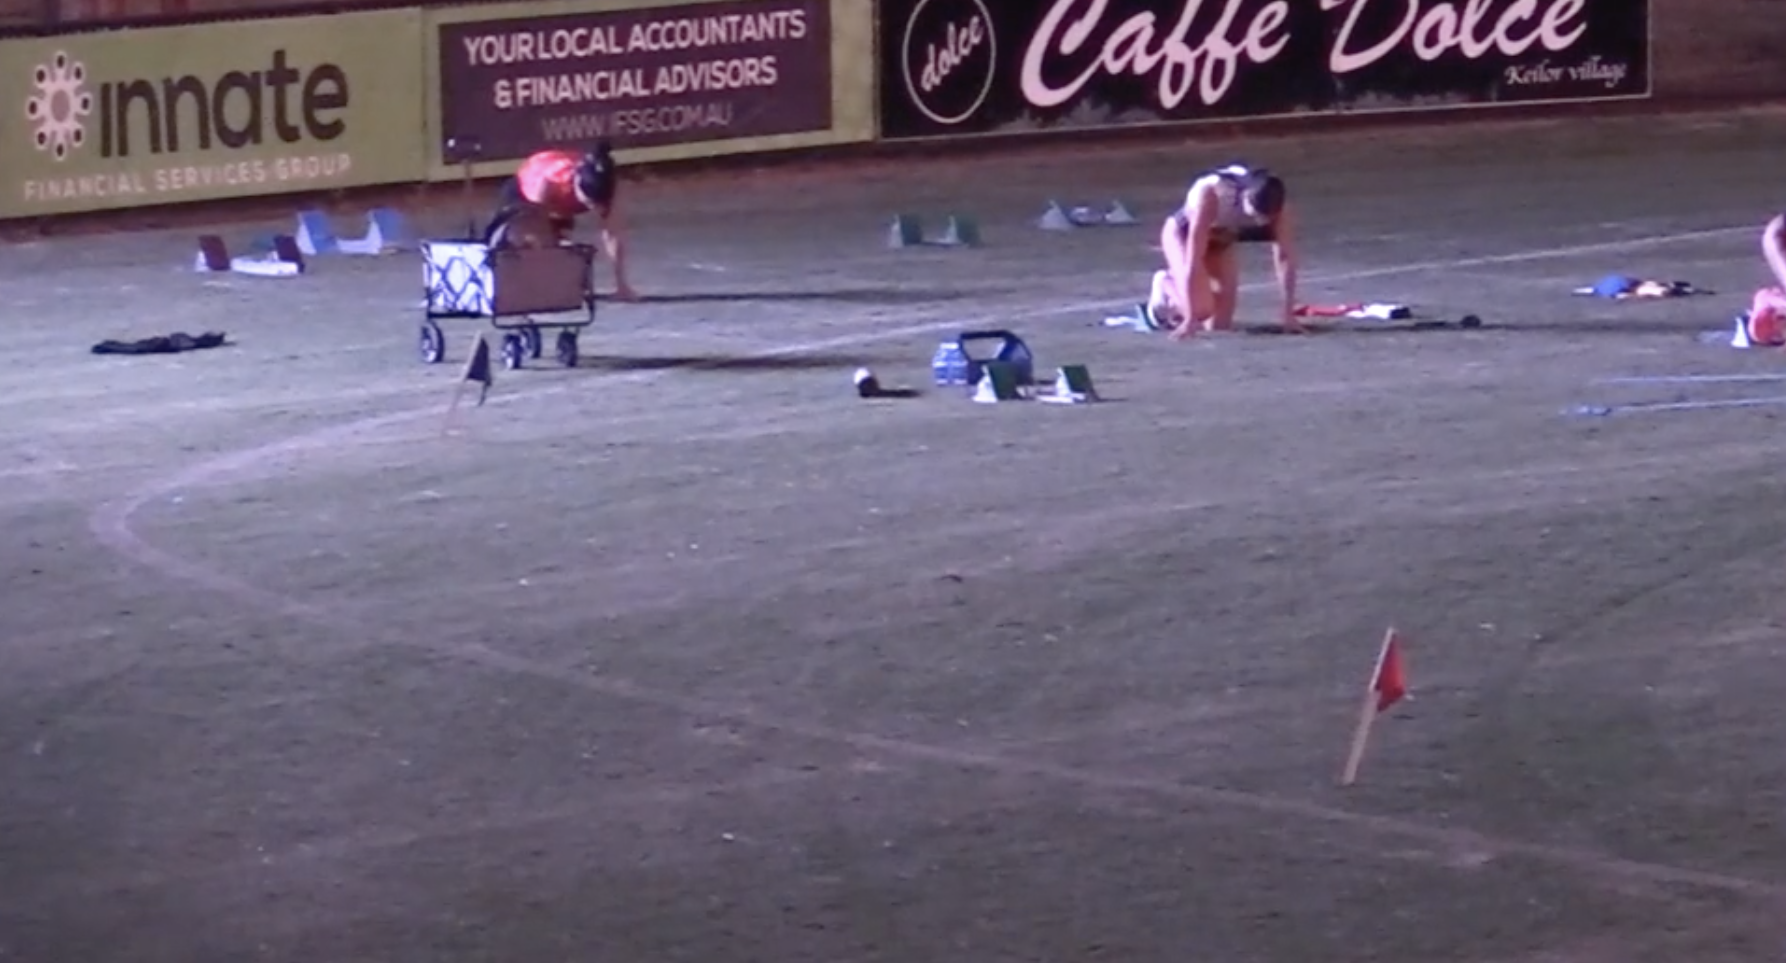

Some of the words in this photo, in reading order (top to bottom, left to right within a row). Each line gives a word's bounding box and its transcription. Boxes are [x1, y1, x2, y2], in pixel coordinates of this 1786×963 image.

[463, 31, 535, 66] YOUR
[538, 22, 623, 59] LOCAL
[627, 9, 807, 52] ACCOUNTANTS
[919, 13, 986, 92] dolce
[516, 68, 650, 106] FINANCIAL
[654, 55, 778, 95] ADVISORS
[1504, 58, 1564, 85] Keilor
[1567, 55, 1627, 88] village
[100, 48, 349, 158] innate
[23, 174, 147, 203] FINANCIAL
[154, 163, 266, 192] SERVICES
[274, 151, 352, 184] GROUP
